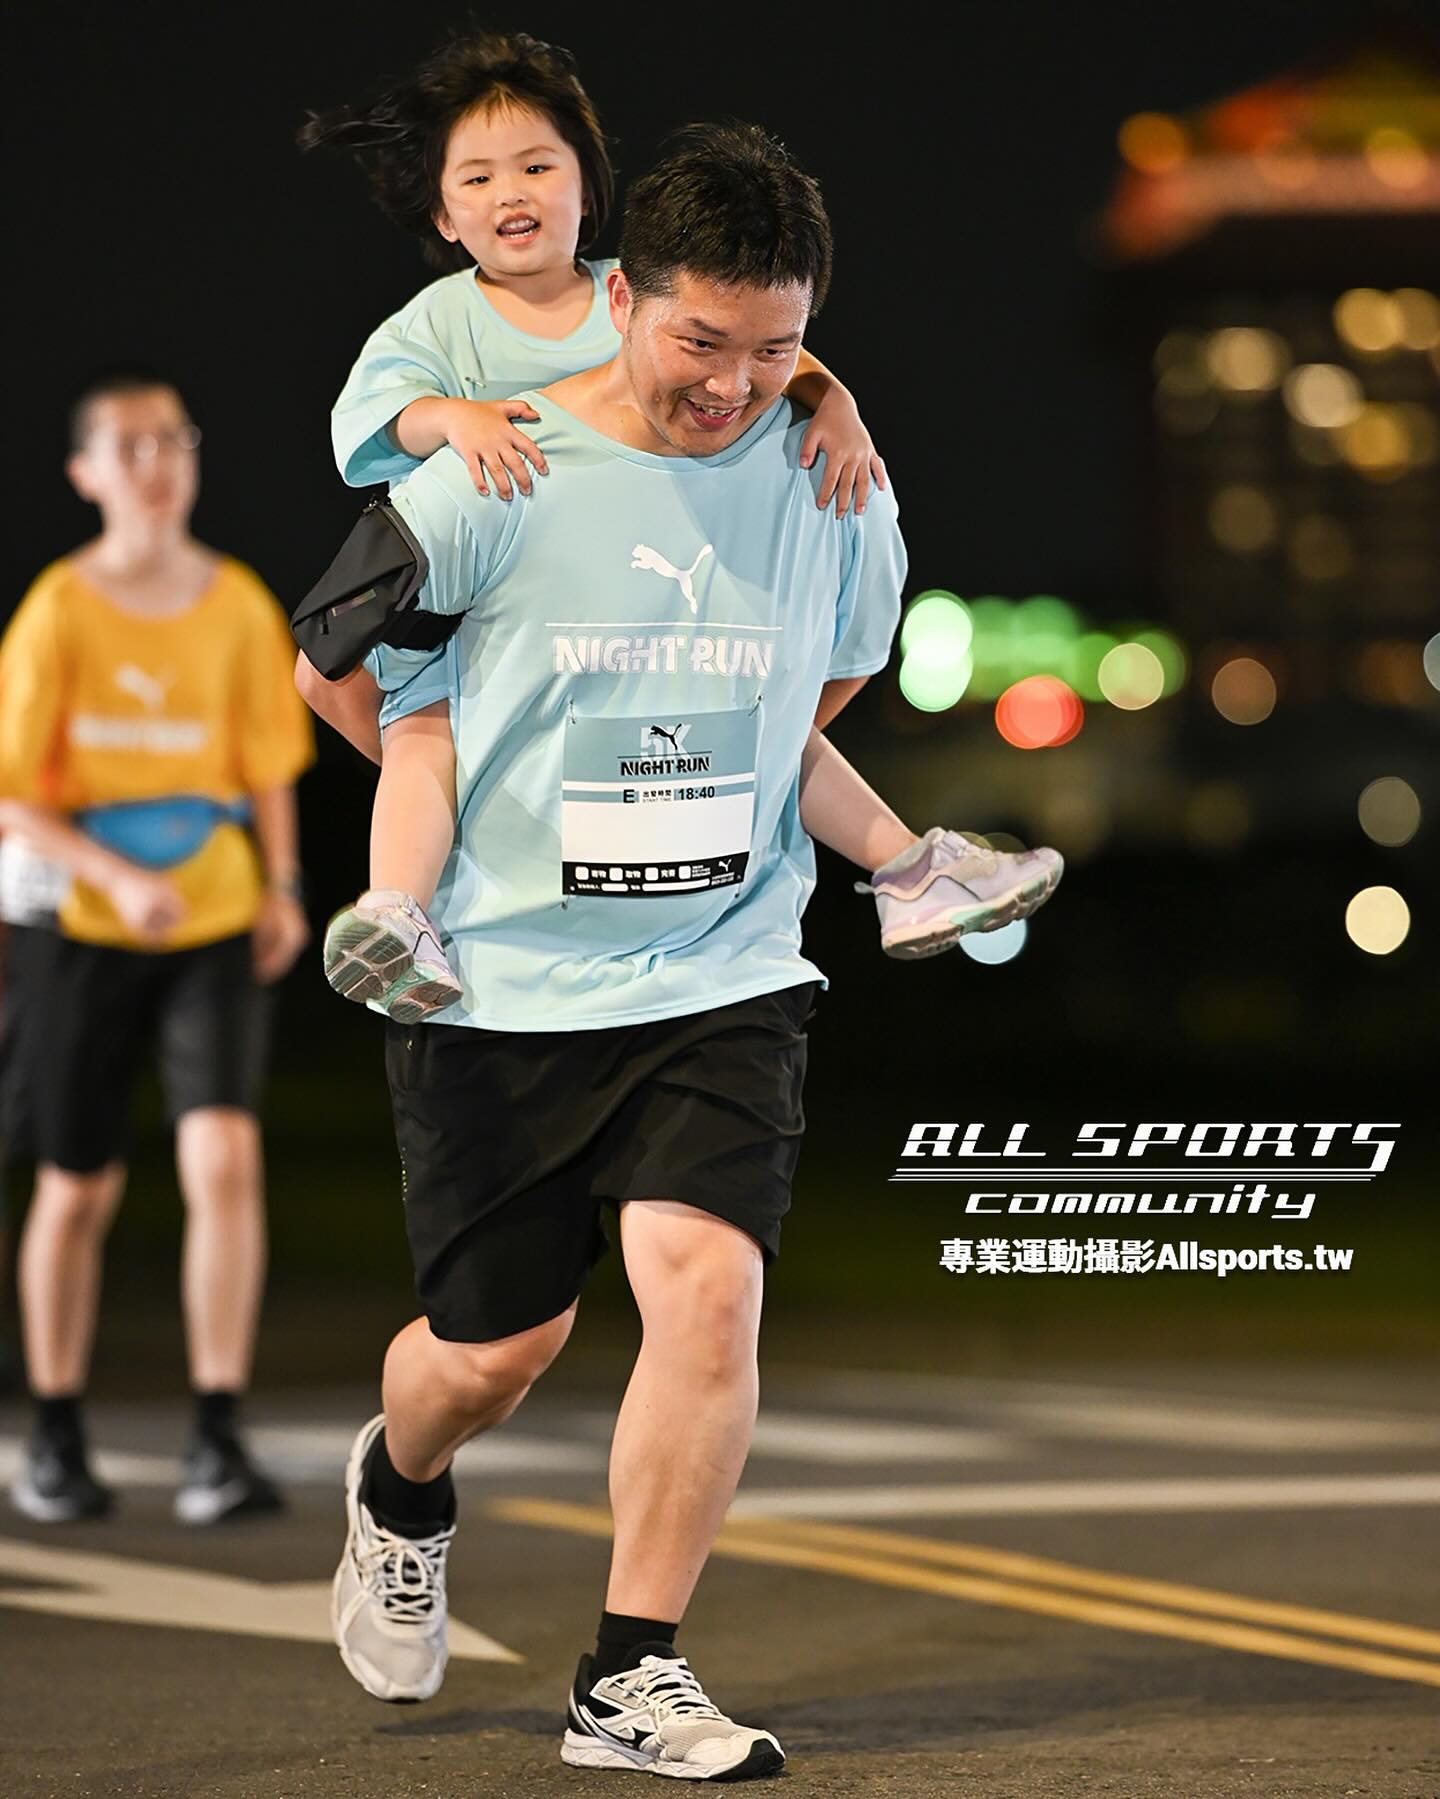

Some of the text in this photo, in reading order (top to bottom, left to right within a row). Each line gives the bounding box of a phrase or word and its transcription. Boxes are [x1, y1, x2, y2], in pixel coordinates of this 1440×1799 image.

[554, 635, 775, 680] NIGHT RUN
[620, 756, 710, 776] NIGHT RUN
[623, 789, 635, 803] E
[678, 786, 715, 800] 18:40
